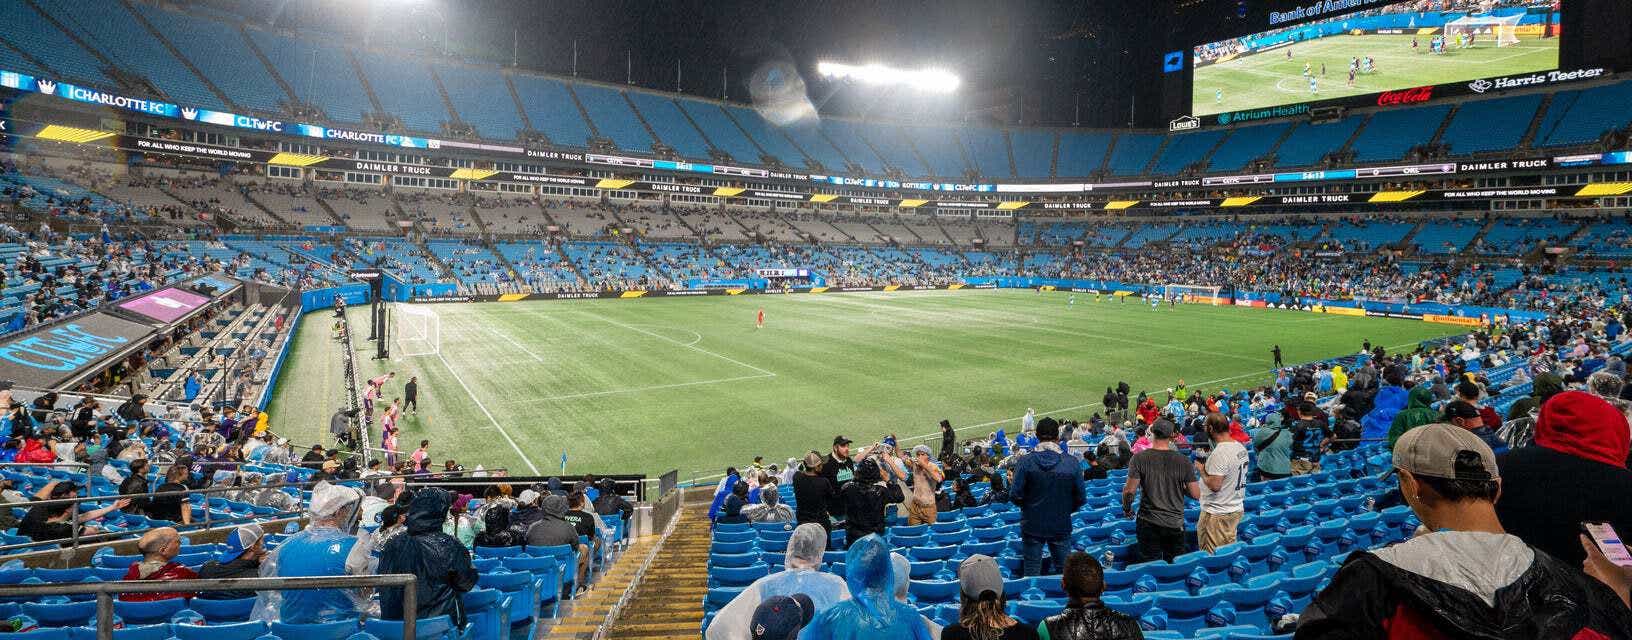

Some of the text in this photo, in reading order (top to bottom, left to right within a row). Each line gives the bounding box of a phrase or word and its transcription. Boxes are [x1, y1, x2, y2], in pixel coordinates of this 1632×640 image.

[1270, 6, 1305, 24] Bank
[1306, 1, 1323, 16] of
[1495, 68, 1604, 89] Harris Teeter
[74, 88, 165, 114] CHARLOTTE FC
[1233, 104, 1310, 121] Atrium Health
[326, 129, 384, 143] CHARLOTTE
[138, 140, 151, 148] FOR
[208, 148, 229, 156] WORLD
[527, 150, 583, 161] DAIMLER TRUCK
[356, 162, 431, 175] DAIMLER TRUCK
[1461, 162, 1507, 171] DAIMLER
[1512, 160, 1547, 168] TRUCK
[652, 183, 680, 192] DAIMLER
